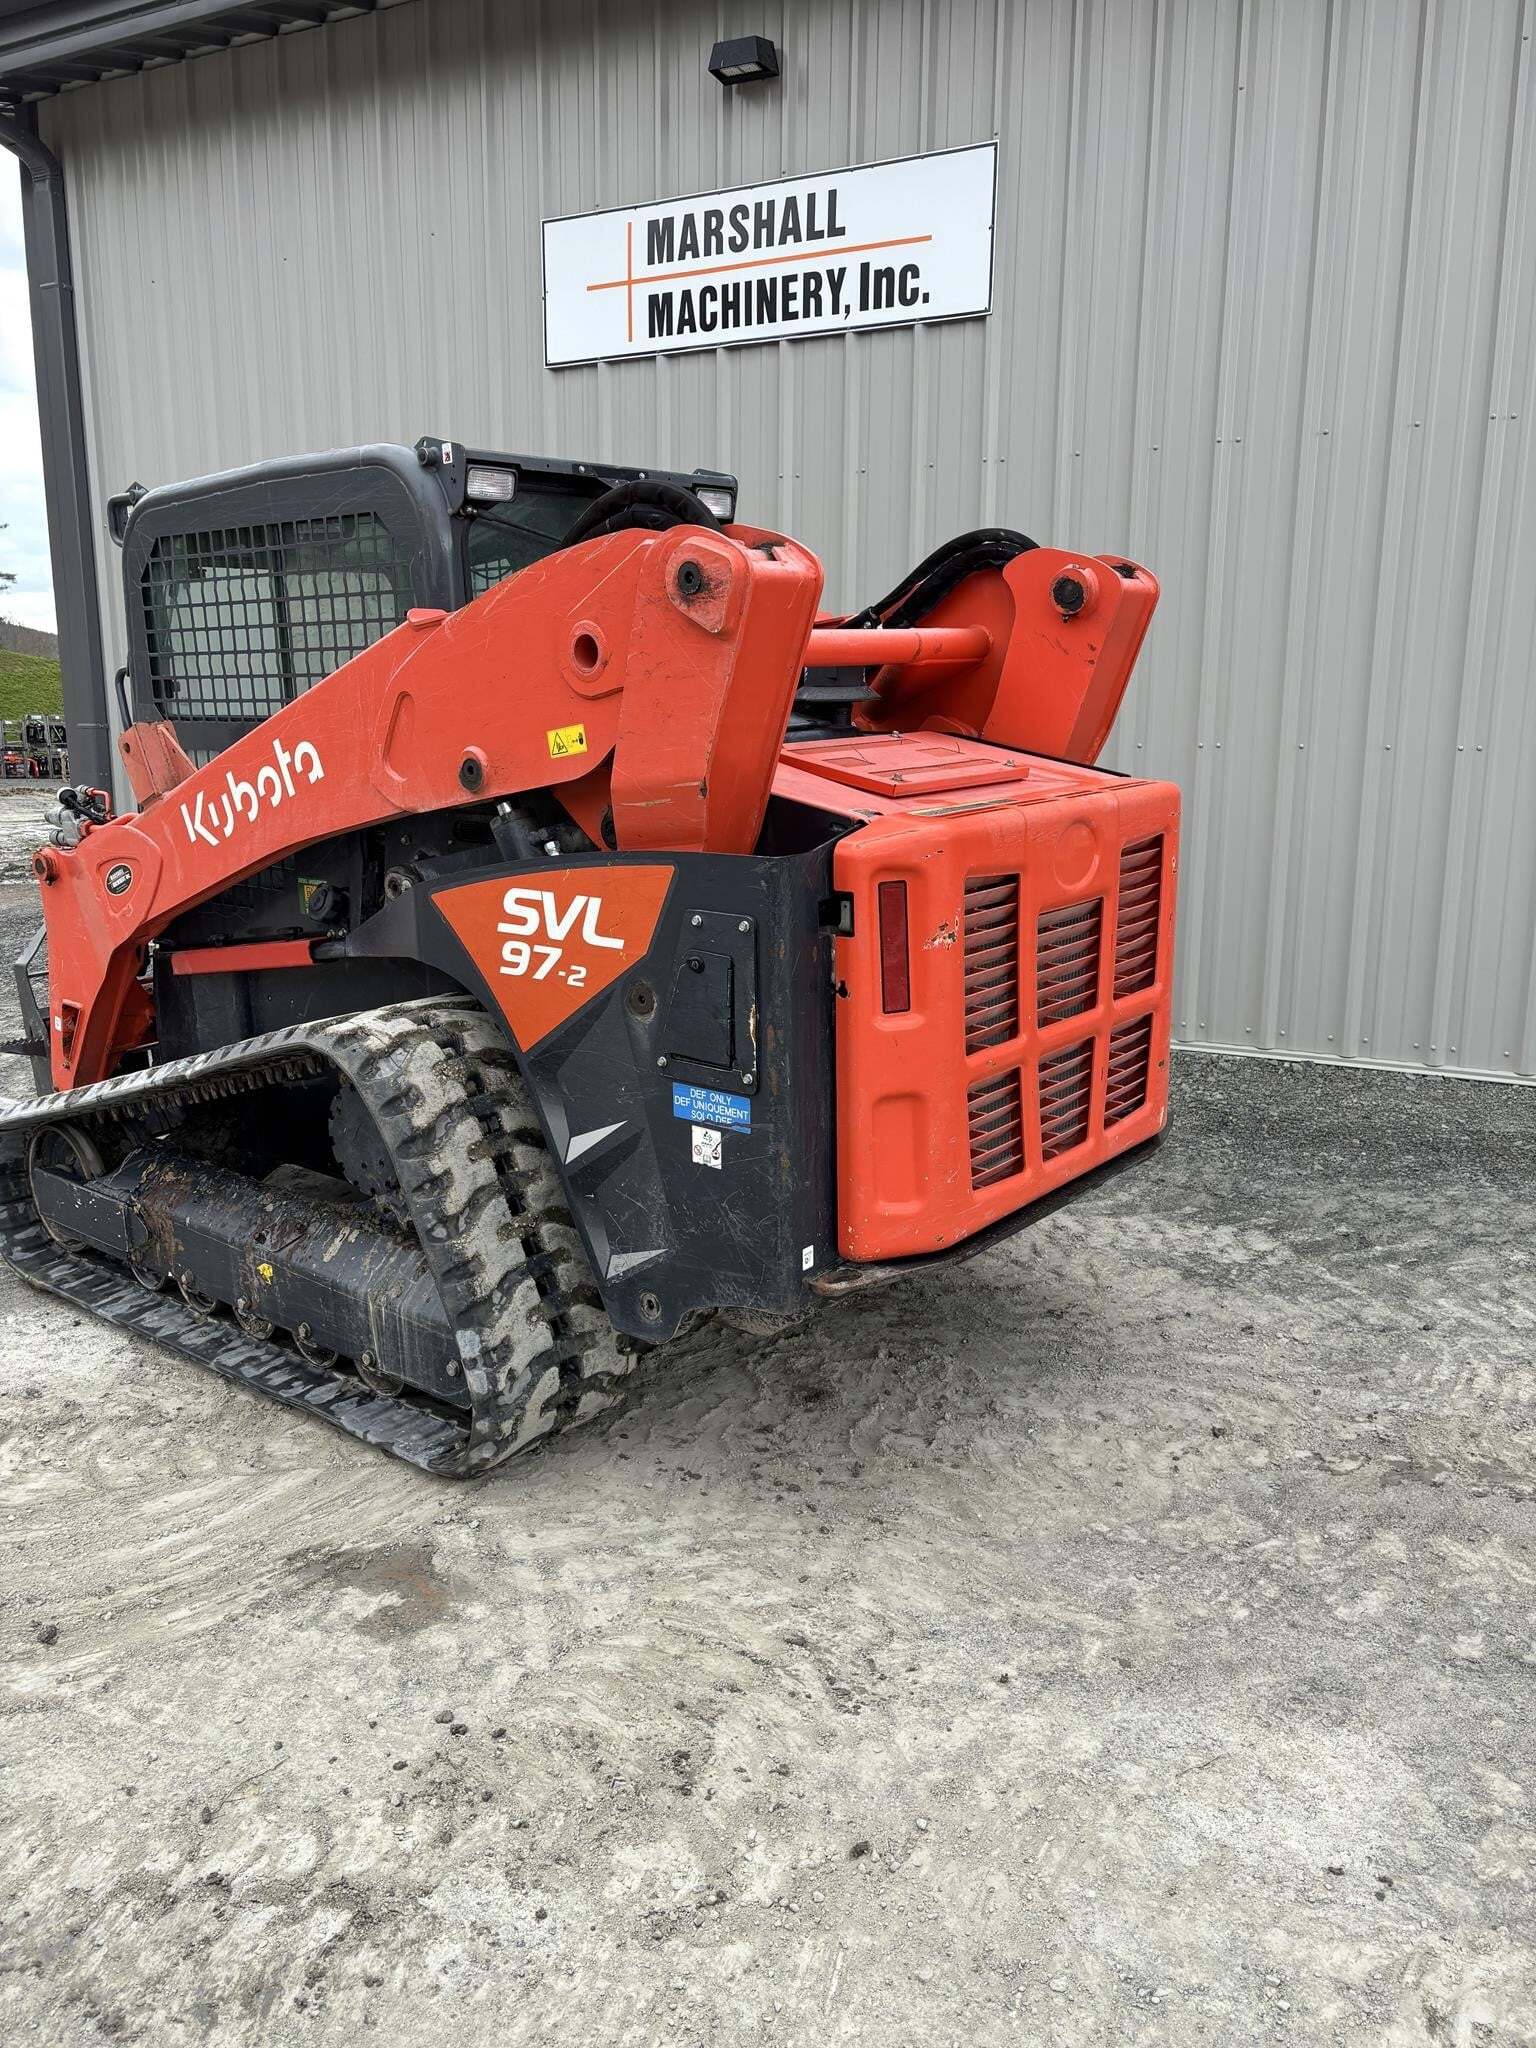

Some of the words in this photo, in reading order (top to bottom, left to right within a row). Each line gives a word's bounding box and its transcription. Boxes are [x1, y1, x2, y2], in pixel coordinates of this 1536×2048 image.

[647, 189, 846, 266] MARSHALL
[648, 267, 851, 339] MACHINERY,
[860, 261, 930, 312] Inc.
[179, 738, 325, 847] Kubota
[496, 887, 625, 950] SVL
[499, 940, 588, 988] 97-2
[674, 1095, 690, 1106] DEF
[693, 1100, 748, 1120] UNIQUEMENT
[690, 1088, 707, 1100] DEF
[709, 1093, 732, 1105] ONLY
